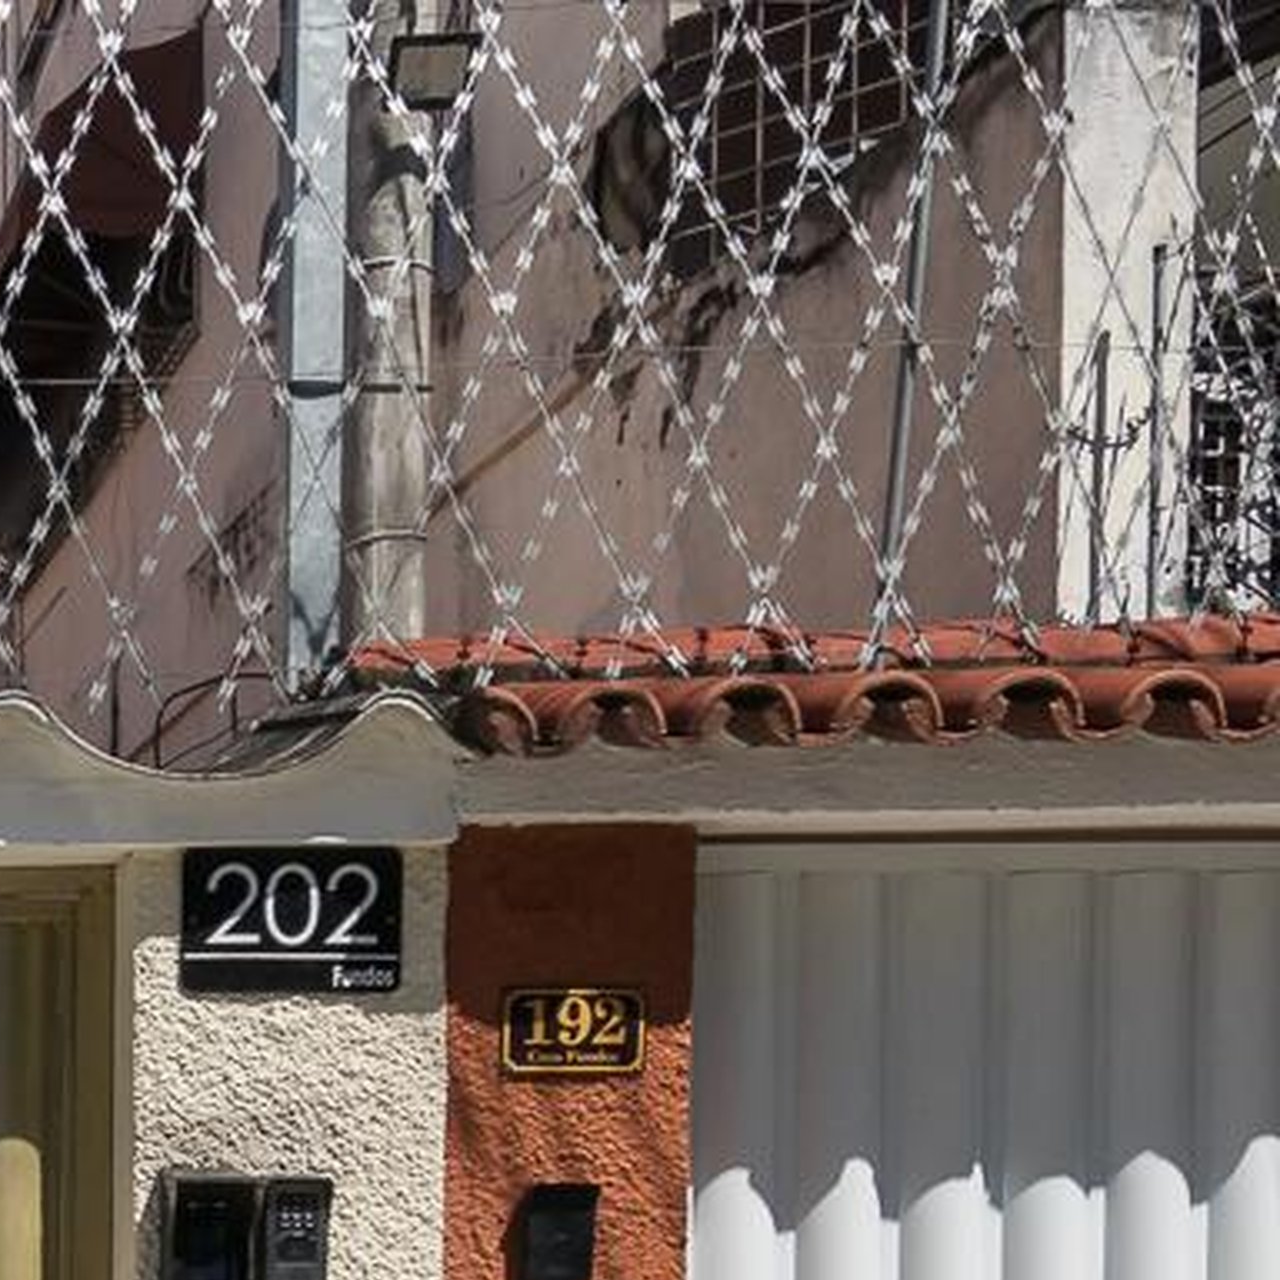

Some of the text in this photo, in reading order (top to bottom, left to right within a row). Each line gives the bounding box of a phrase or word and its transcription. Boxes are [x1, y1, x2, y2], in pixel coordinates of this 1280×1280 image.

[205, 862, 379, 946] 202
[332, 964, 395, 988] Fundos
[521, 996, 627, 1046] 192
